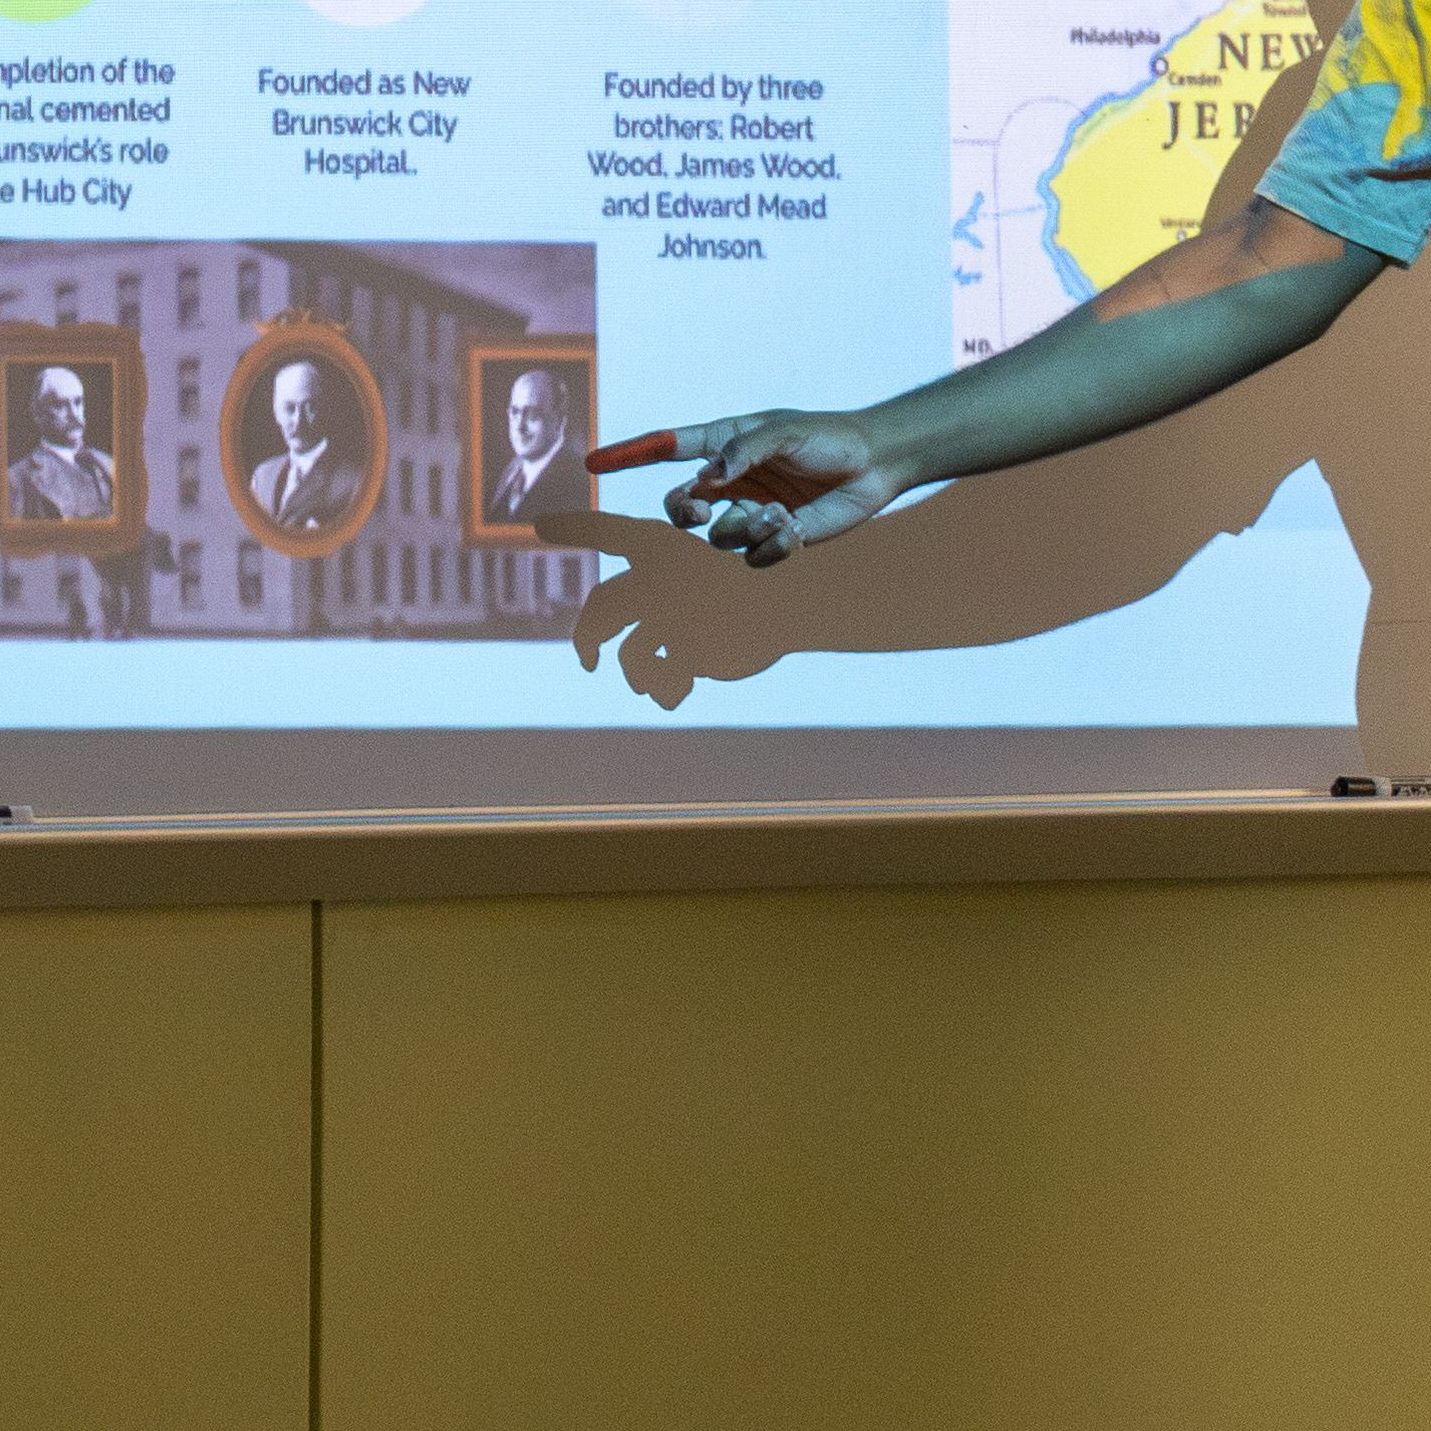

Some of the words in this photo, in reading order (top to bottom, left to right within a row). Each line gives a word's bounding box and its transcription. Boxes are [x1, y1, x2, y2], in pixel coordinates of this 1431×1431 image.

[1069, 27, 1162, 46] Philadelphia
[1217, 31, 1320, 71] NEW
[100, 56, 129, 85] of
[132, 57, 176, 86] the
[257, 67, 373, 96] Founded
[377, 74, 407, 96] as
[412, 70, 472, 98] New
[1168, 71, 1222, 88] Camden
[603, 71, 716, 100] Founded
[721, 73, 754, 107] by
[757, 74, 825, 101] three
[39, 96, 171, 124] cemented
[272, 108, 403, 138] Brunswick
[407, 109, 459, 144] City
[730, 112, 815, 142] Robert
[118, 136, 170, 165] role
[674, 152, 756, 179] James
[21, 177, 77, 206] Hub
[81, 177, 133, 212] City
[601, 191, 651, 219] and
[655, 190, 752, 220] Edward
[757, 193, 828, 221] Mead
